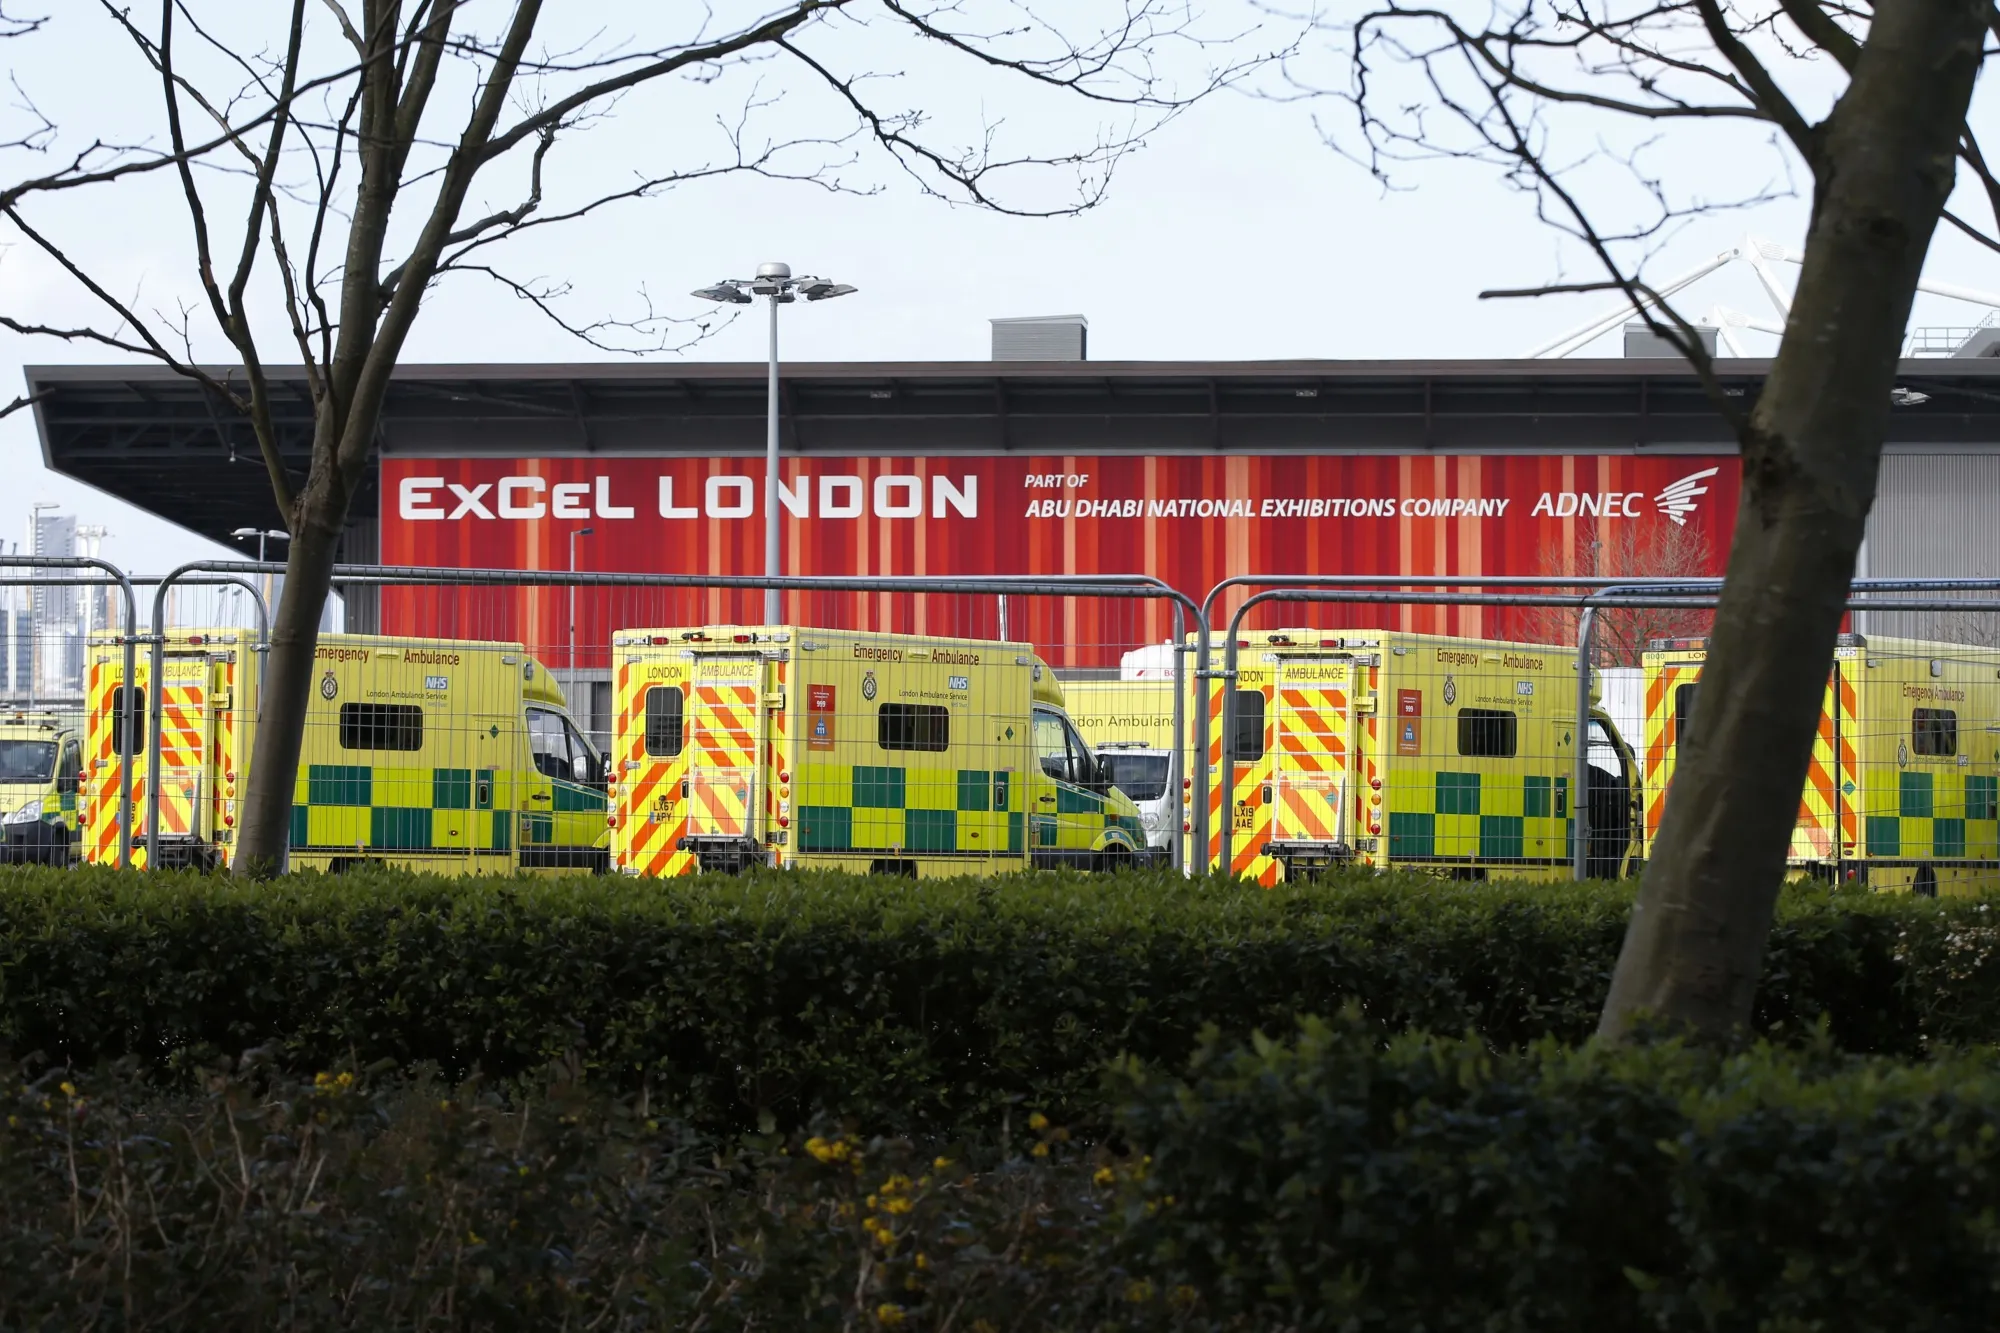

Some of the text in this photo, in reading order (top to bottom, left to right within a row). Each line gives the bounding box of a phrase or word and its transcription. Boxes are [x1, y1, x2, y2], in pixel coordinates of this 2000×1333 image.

[1024, 474, 1089, 488] PART OF
[659, 475, 977, 518] LONDON
[1025, 498, 1510, 518] ABU DHABI NATIONAL EXHIBITIONS COMPANY
[1530, 492, 1644, 517] ADNEC
[404, 648, 460, 665] Ambulance
[854, 643, 979, 666] Emergency Ambulance
[1837, 648, 1856, 657] NHS
[1437, 648, 1543, 671] Emergency Ambulance
[115, 667, 145, 678] LOON
[162, 665, 202, 677] MBULANCE
[647, 666, 682, 678] LONDON
[701, 665, 754, 677] AMBULANCE
[1237, 671, 1264, 682] NDON
[1285, 667, 1344, 680] AMBULANCE
[426, 677, 447, 689] NHS
[949, 677, 967, 689] NHS
[1517, 682, 1533, 694] NHS
[366, 690, 447, 701] London Ambulance Service
[899, 690, 968, 701] London Ambulance Service
[1903, 682, 1965, 702] Emergency Ambulance
[1108, 715, 1180, 727] Ambulanc
[653, 801, 675, 811] LX67
[1234, 807, 1254, 817] LX19
[656, 812, 672, 822] APY
[1235, 818, 1253, 828] AAE
